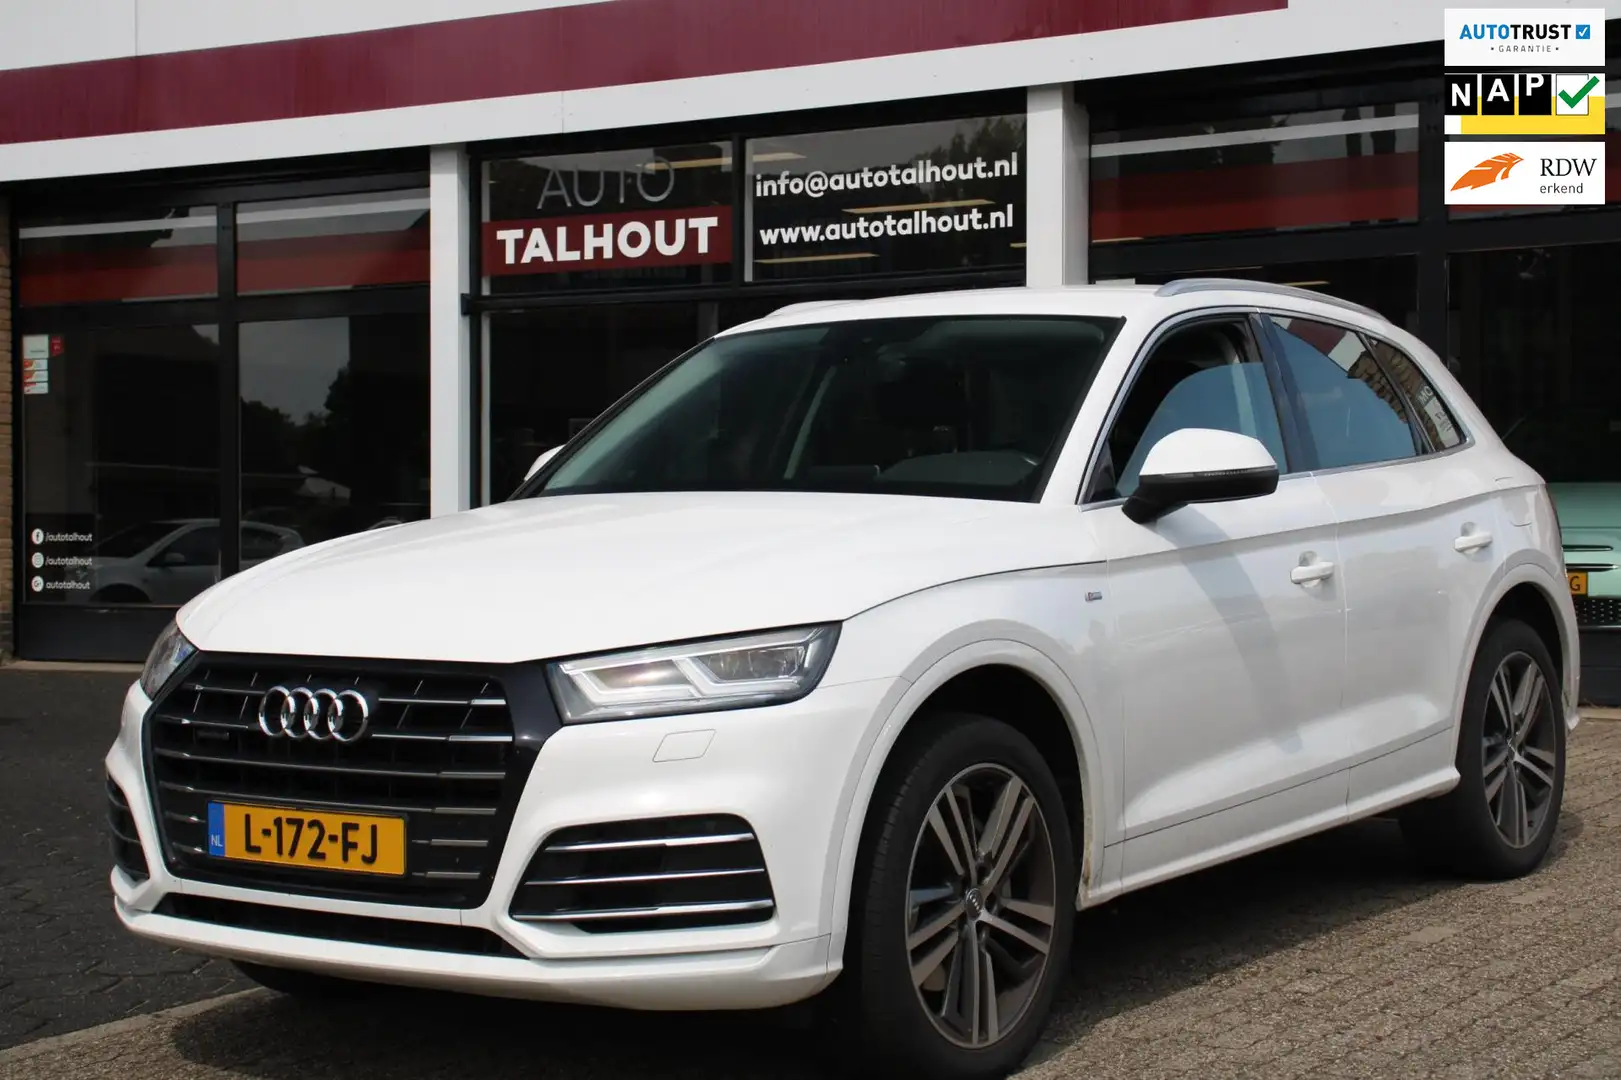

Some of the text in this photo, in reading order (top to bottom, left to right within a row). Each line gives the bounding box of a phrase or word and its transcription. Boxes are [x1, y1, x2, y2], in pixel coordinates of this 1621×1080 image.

[536, 155, 675, 210] AUTO
[755, 151, 1018, 198] info@autotalhout.nl
[496, 216, 719, 265] TALHOUT
[759, 203, 1014, 246] www.autotalhout.nl
[210, 834, 223, 847] NL
[244, 813, 378, 865] L-172-FJ
